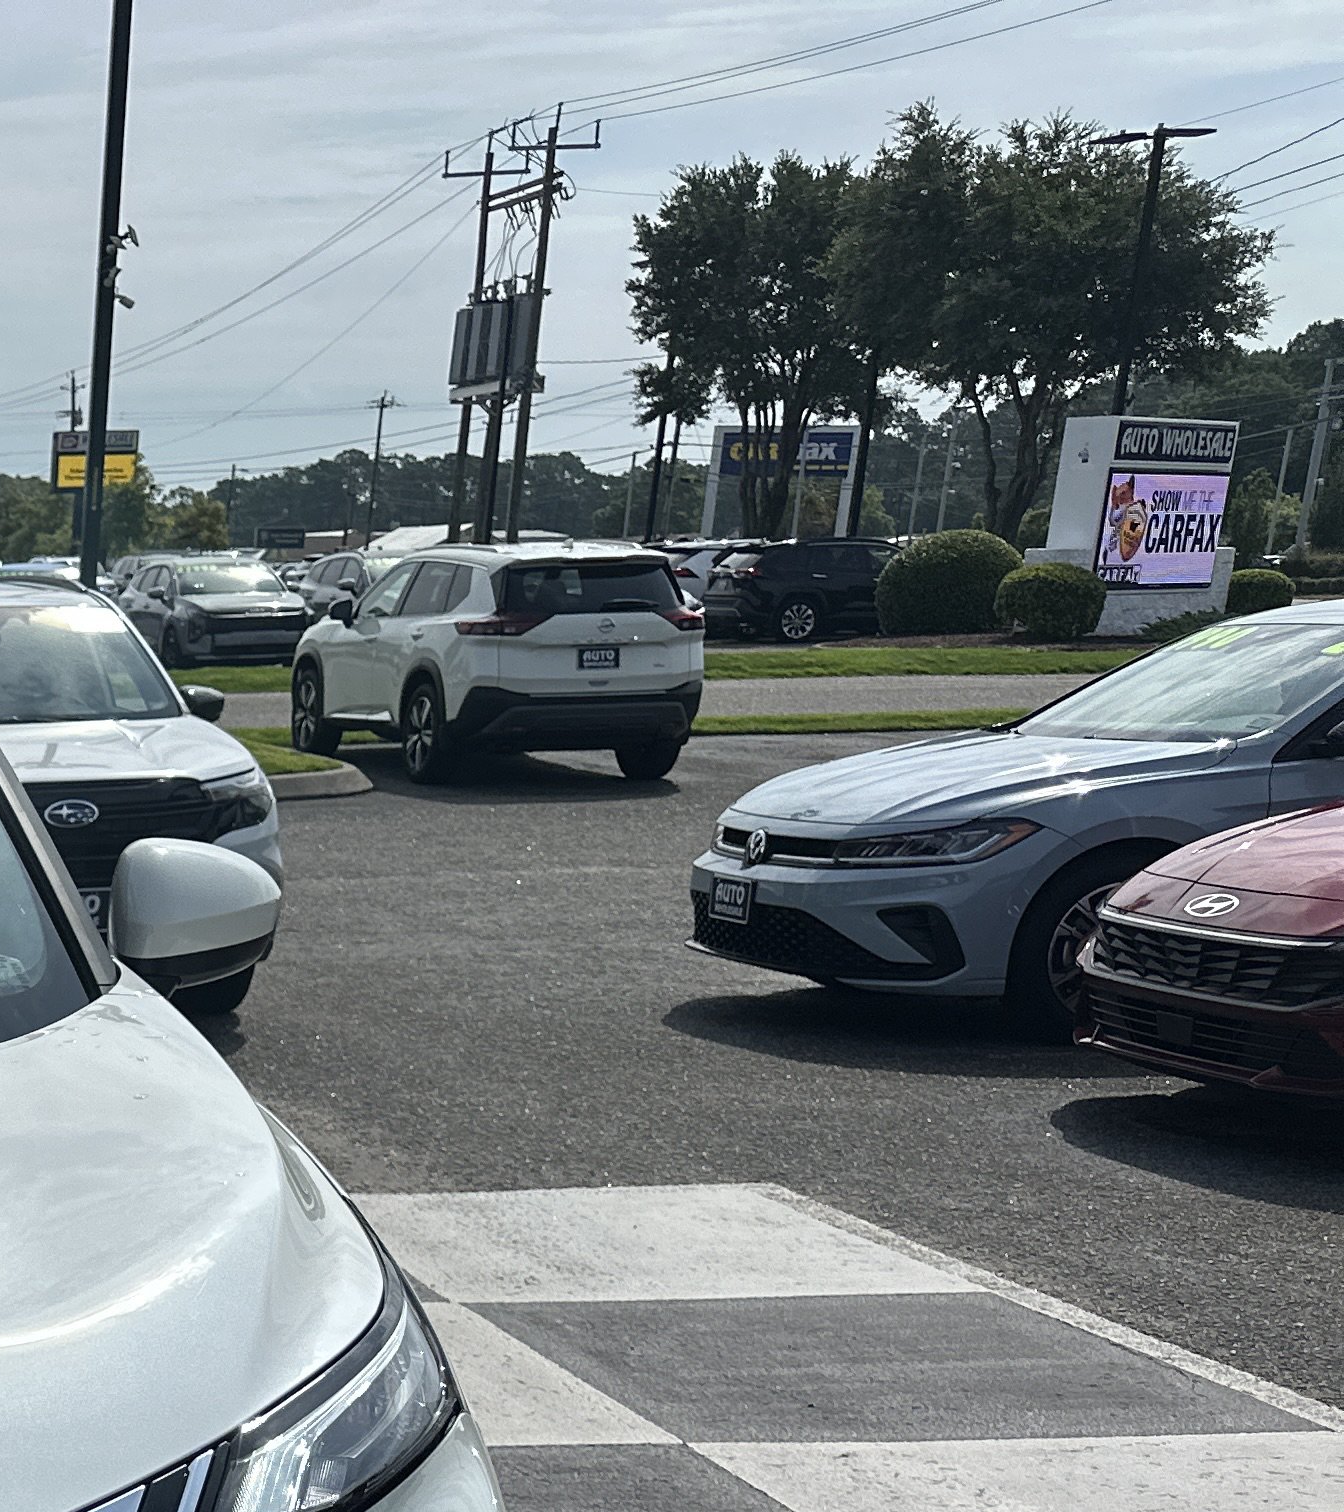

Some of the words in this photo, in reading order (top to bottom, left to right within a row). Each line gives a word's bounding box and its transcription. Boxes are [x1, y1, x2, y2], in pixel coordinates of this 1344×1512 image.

[1120, 427, 1160, 455] AUTO
[1162, 429, 1234, 458] WHOLESALE
[1151, 490, 1182, 513] SHOW
[1144, 514, 1223, 553] CARFAX
[582, 650, 615, 661] AUTO
[715, 883, 746, 905] AUTO
